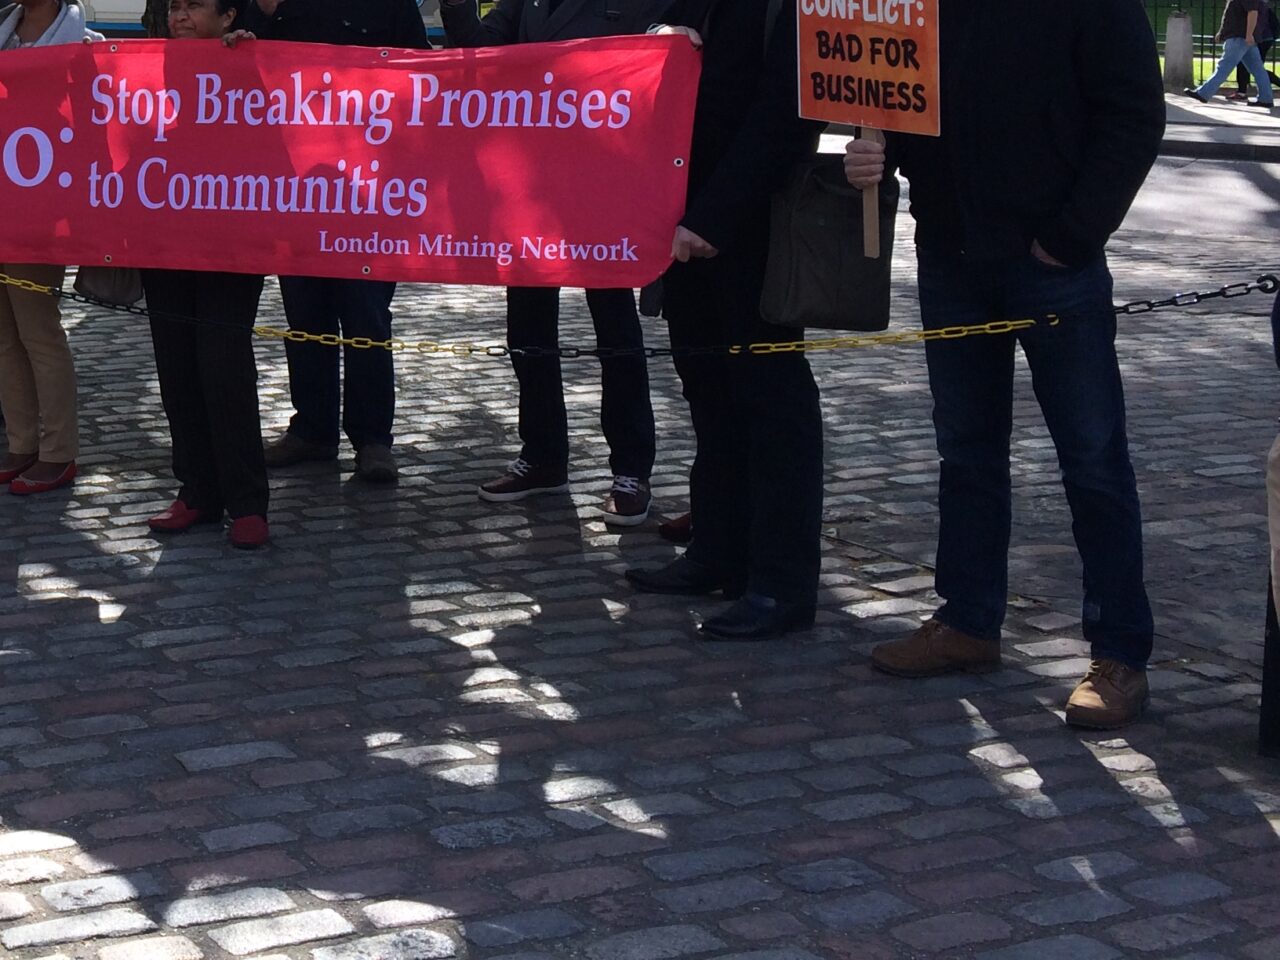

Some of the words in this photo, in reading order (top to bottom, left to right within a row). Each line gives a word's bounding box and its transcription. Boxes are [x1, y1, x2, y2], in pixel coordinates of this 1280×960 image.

[816, 30, 863, 63] BAD
[868, 37, 920, 71] FOR
[91, 73, 181, 143] Stop
[195, 71, 395, 145] Breaking
[406, 72, 632, 130] Promises
[811, 71, 928, 113] BUSINESS
[88, 161, 124, 209] to
[137, 157, 428, 218] Communities
[319, 230, 410, 256] London
[418, 233, 513, 266] Mining
[521, 236, 639, 263] Network
